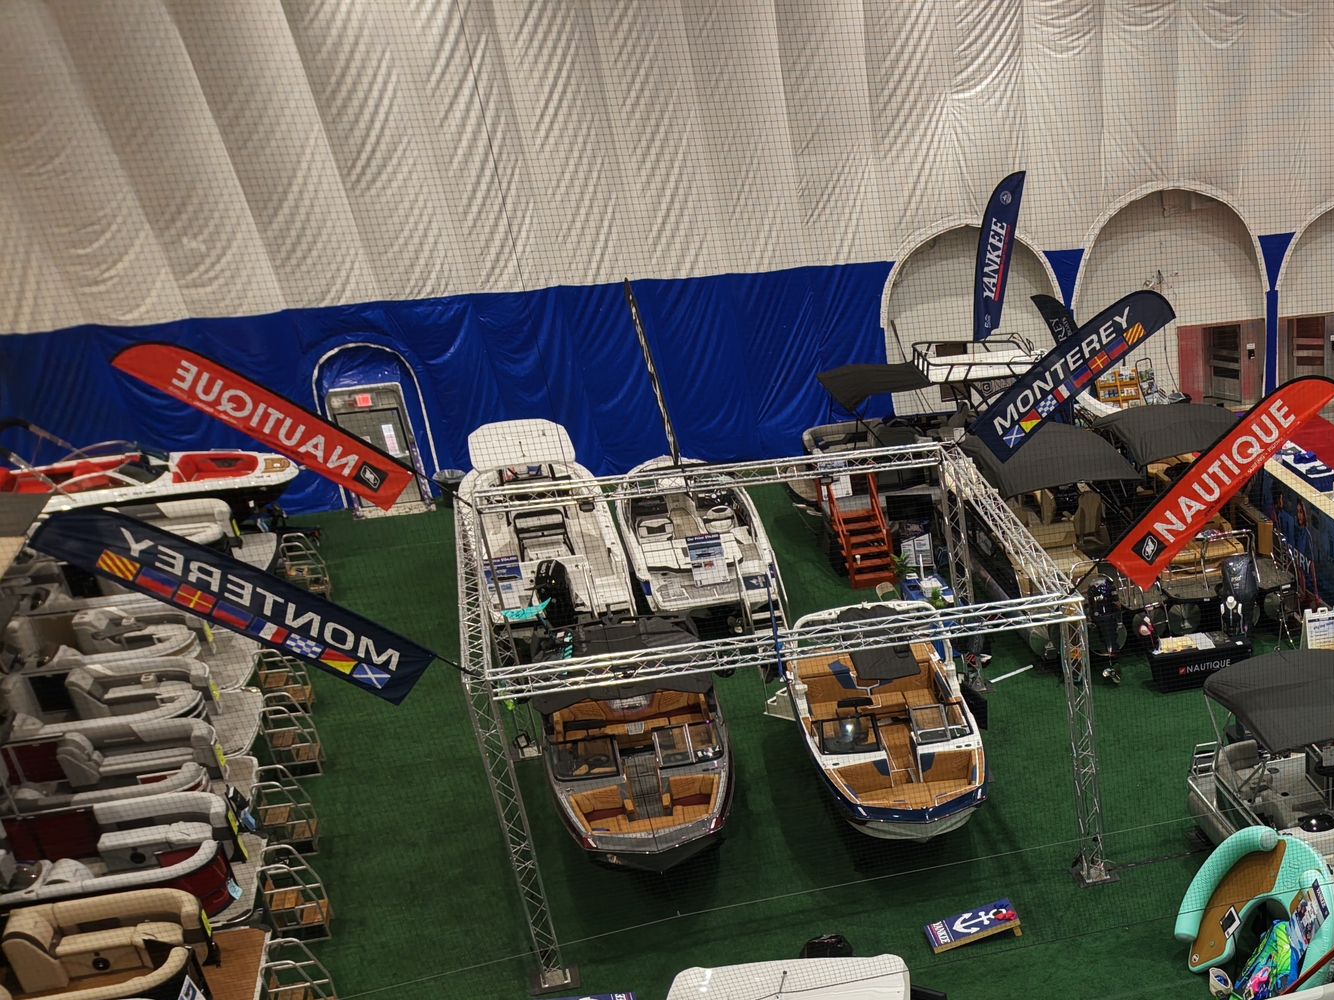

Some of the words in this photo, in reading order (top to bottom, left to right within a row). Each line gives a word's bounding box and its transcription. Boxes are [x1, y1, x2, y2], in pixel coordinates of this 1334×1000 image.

[983, 217, 1007, 300] YANKEE
[993, 306, 1131, 437] MONTEREY
[1153, 398, 1298, 543] NAUTIQUE
[1186, 658, 1231, 674] NAUTIQUE
[931, 921, 950, 945] YANKEE
